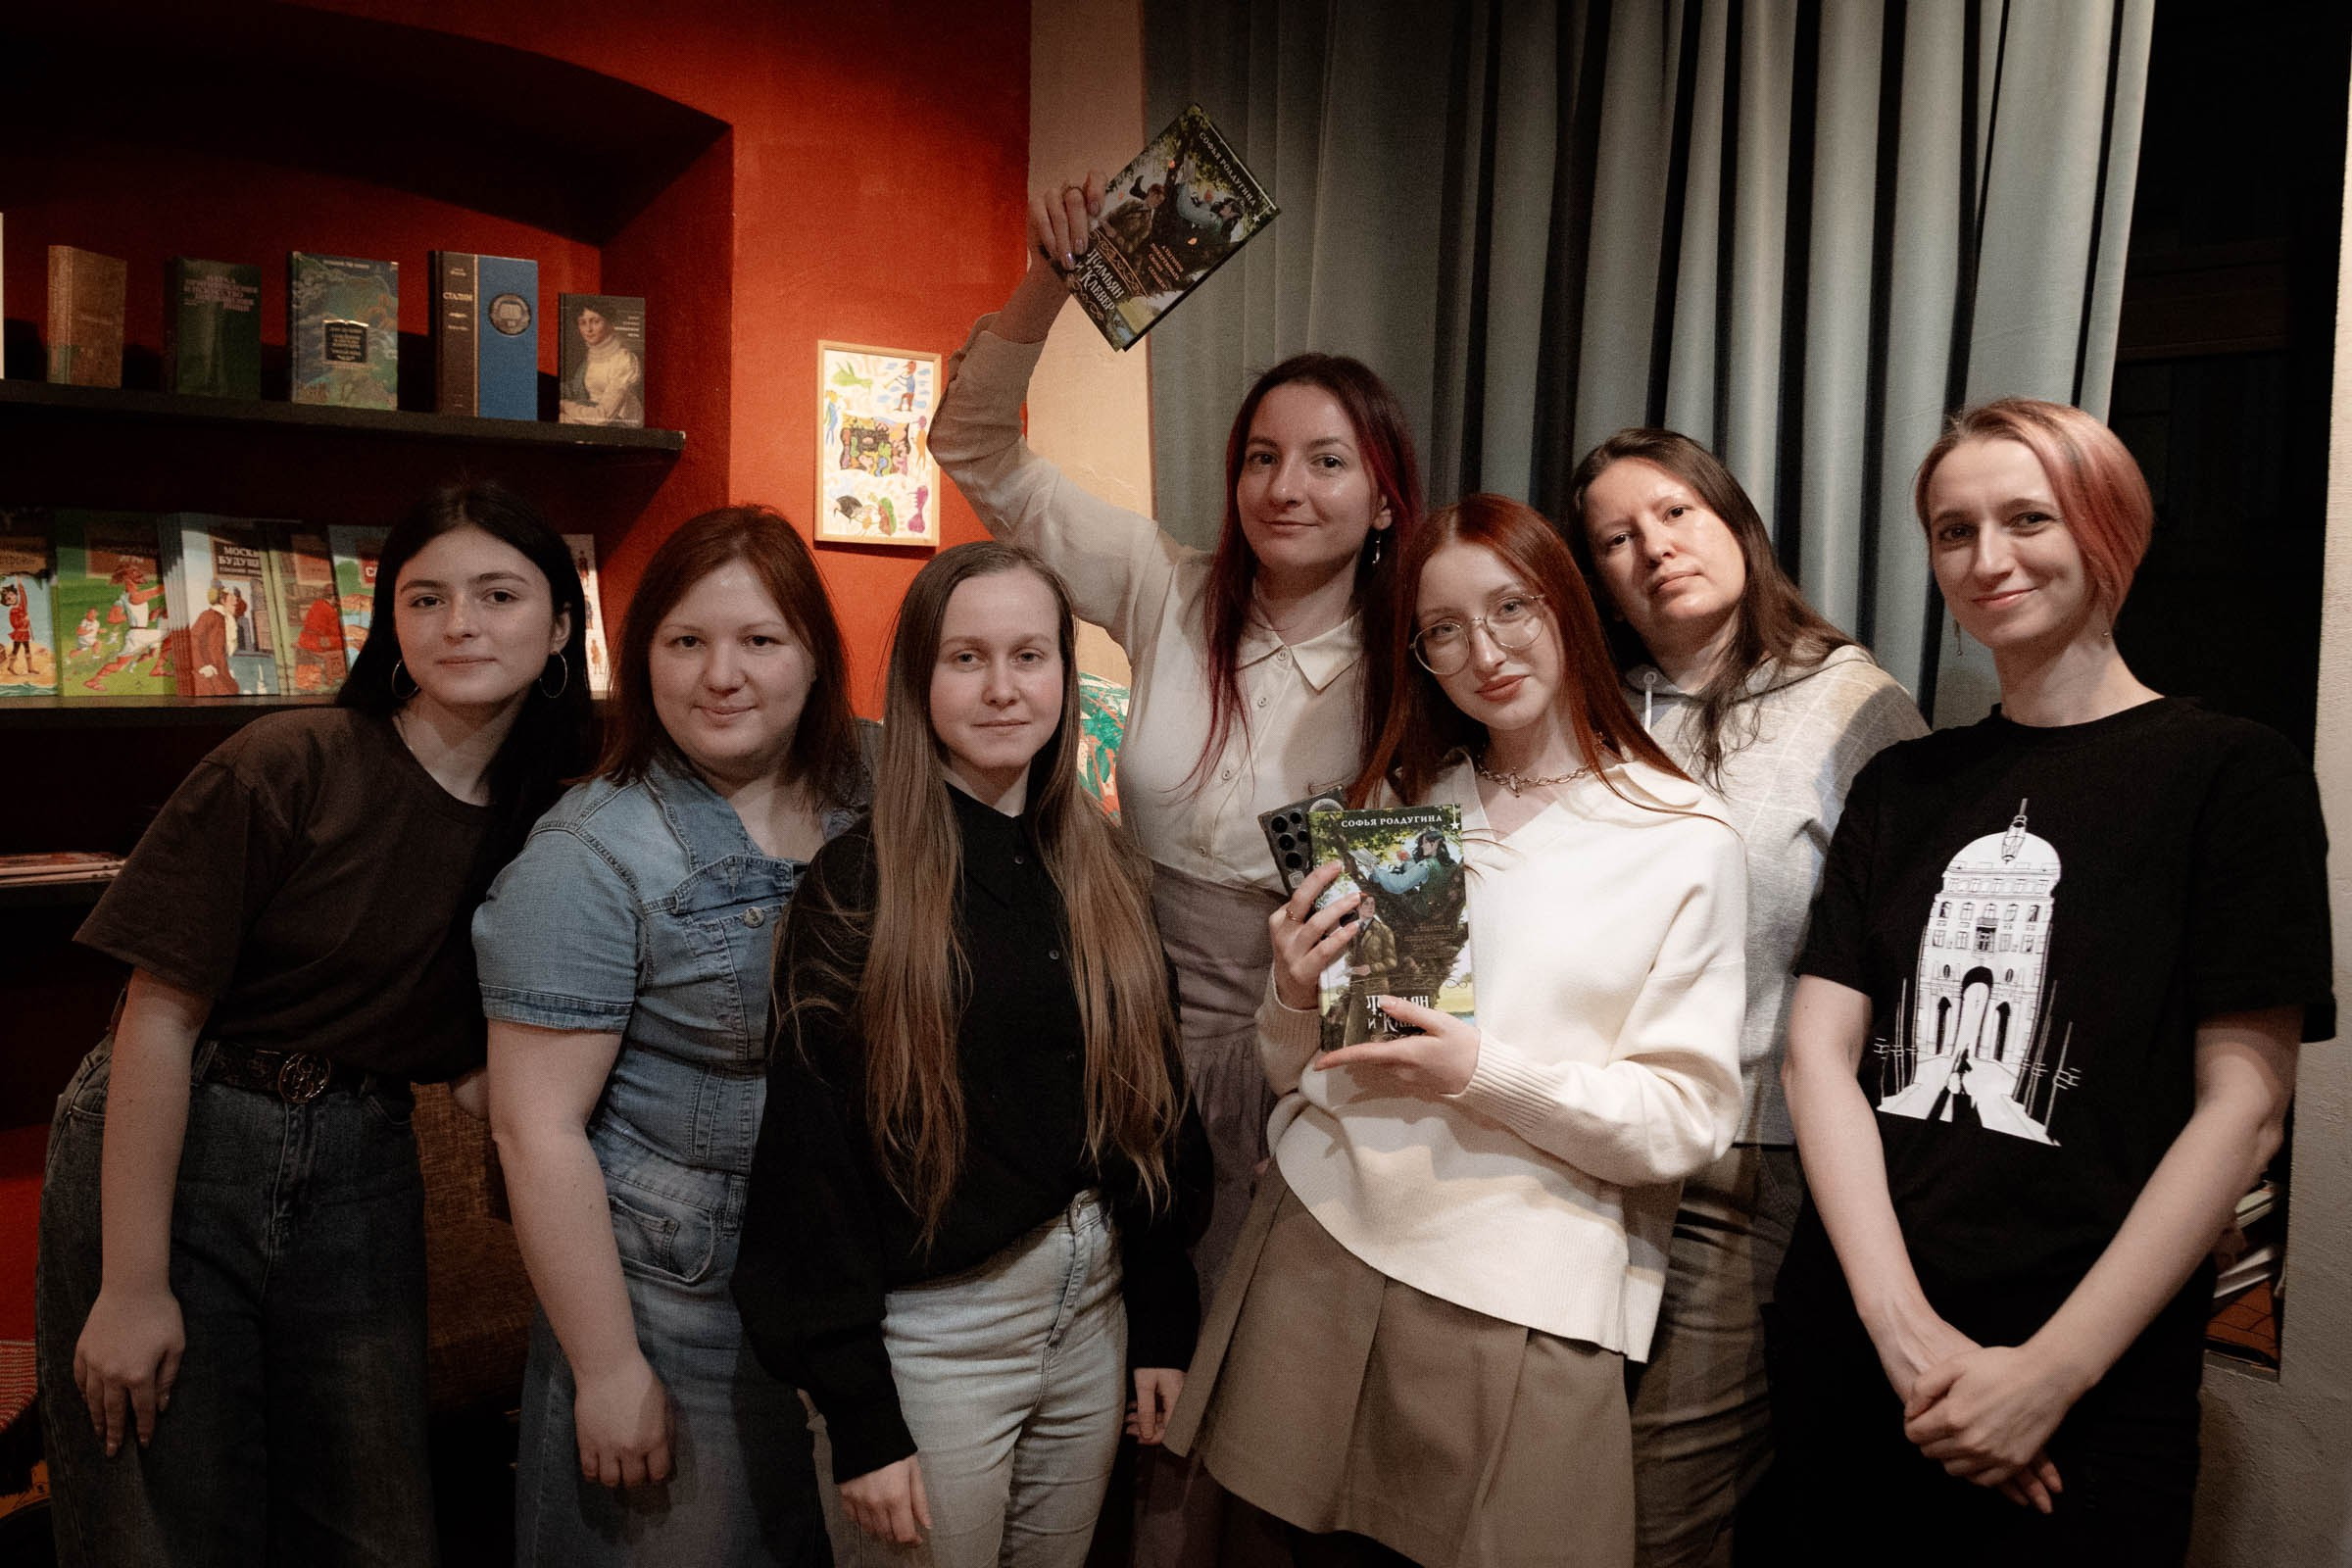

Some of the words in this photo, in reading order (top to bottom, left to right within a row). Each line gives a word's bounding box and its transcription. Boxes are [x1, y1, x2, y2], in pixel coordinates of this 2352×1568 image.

[1199, 131, 1222, 161] СОФЬЯ
[1220, 159, 1257, 207] РОЛДУГИНА
[1079, 266, 1116, 311] КЛЕВЕР
[1086, 248, 1125, 299] ТИМЬЯН
[223, 546, 259, 558] МОСКВ
[1341, 818, 1378, 828] СОФЬЯ
[1380, 814, 1443, 826] РОЛДУГИНА
